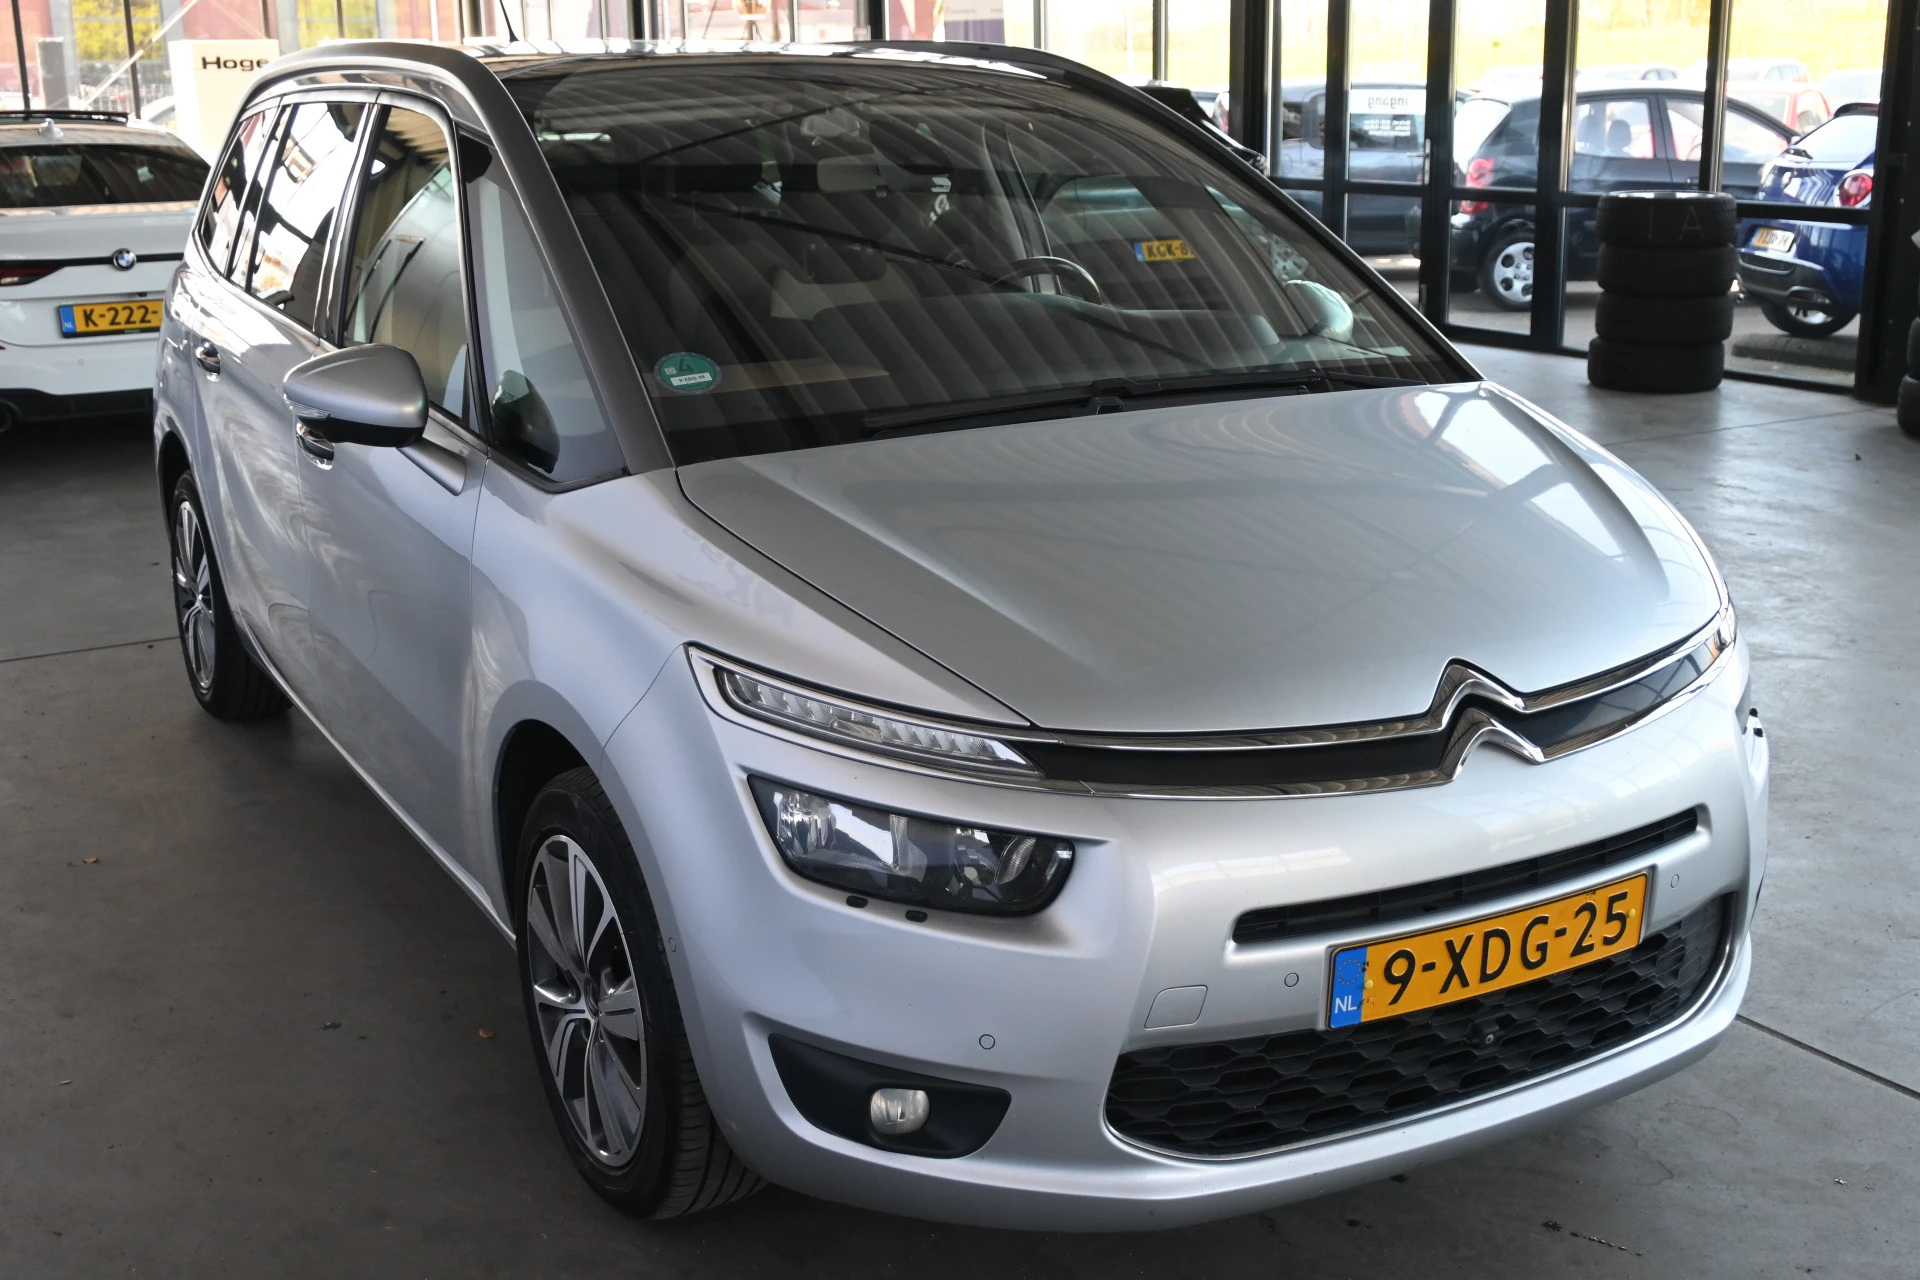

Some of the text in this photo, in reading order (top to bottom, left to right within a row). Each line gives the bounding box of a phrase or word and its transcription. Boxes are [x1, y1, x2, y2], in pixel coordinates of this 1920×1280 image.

[1146, 242, 1194, 258] KGK-8
[83, 304, 160, 328] K-222-
[1383, 891, 1629, 1006] 9-XDG-25
[1334, 995, 1357, 1015] NL
